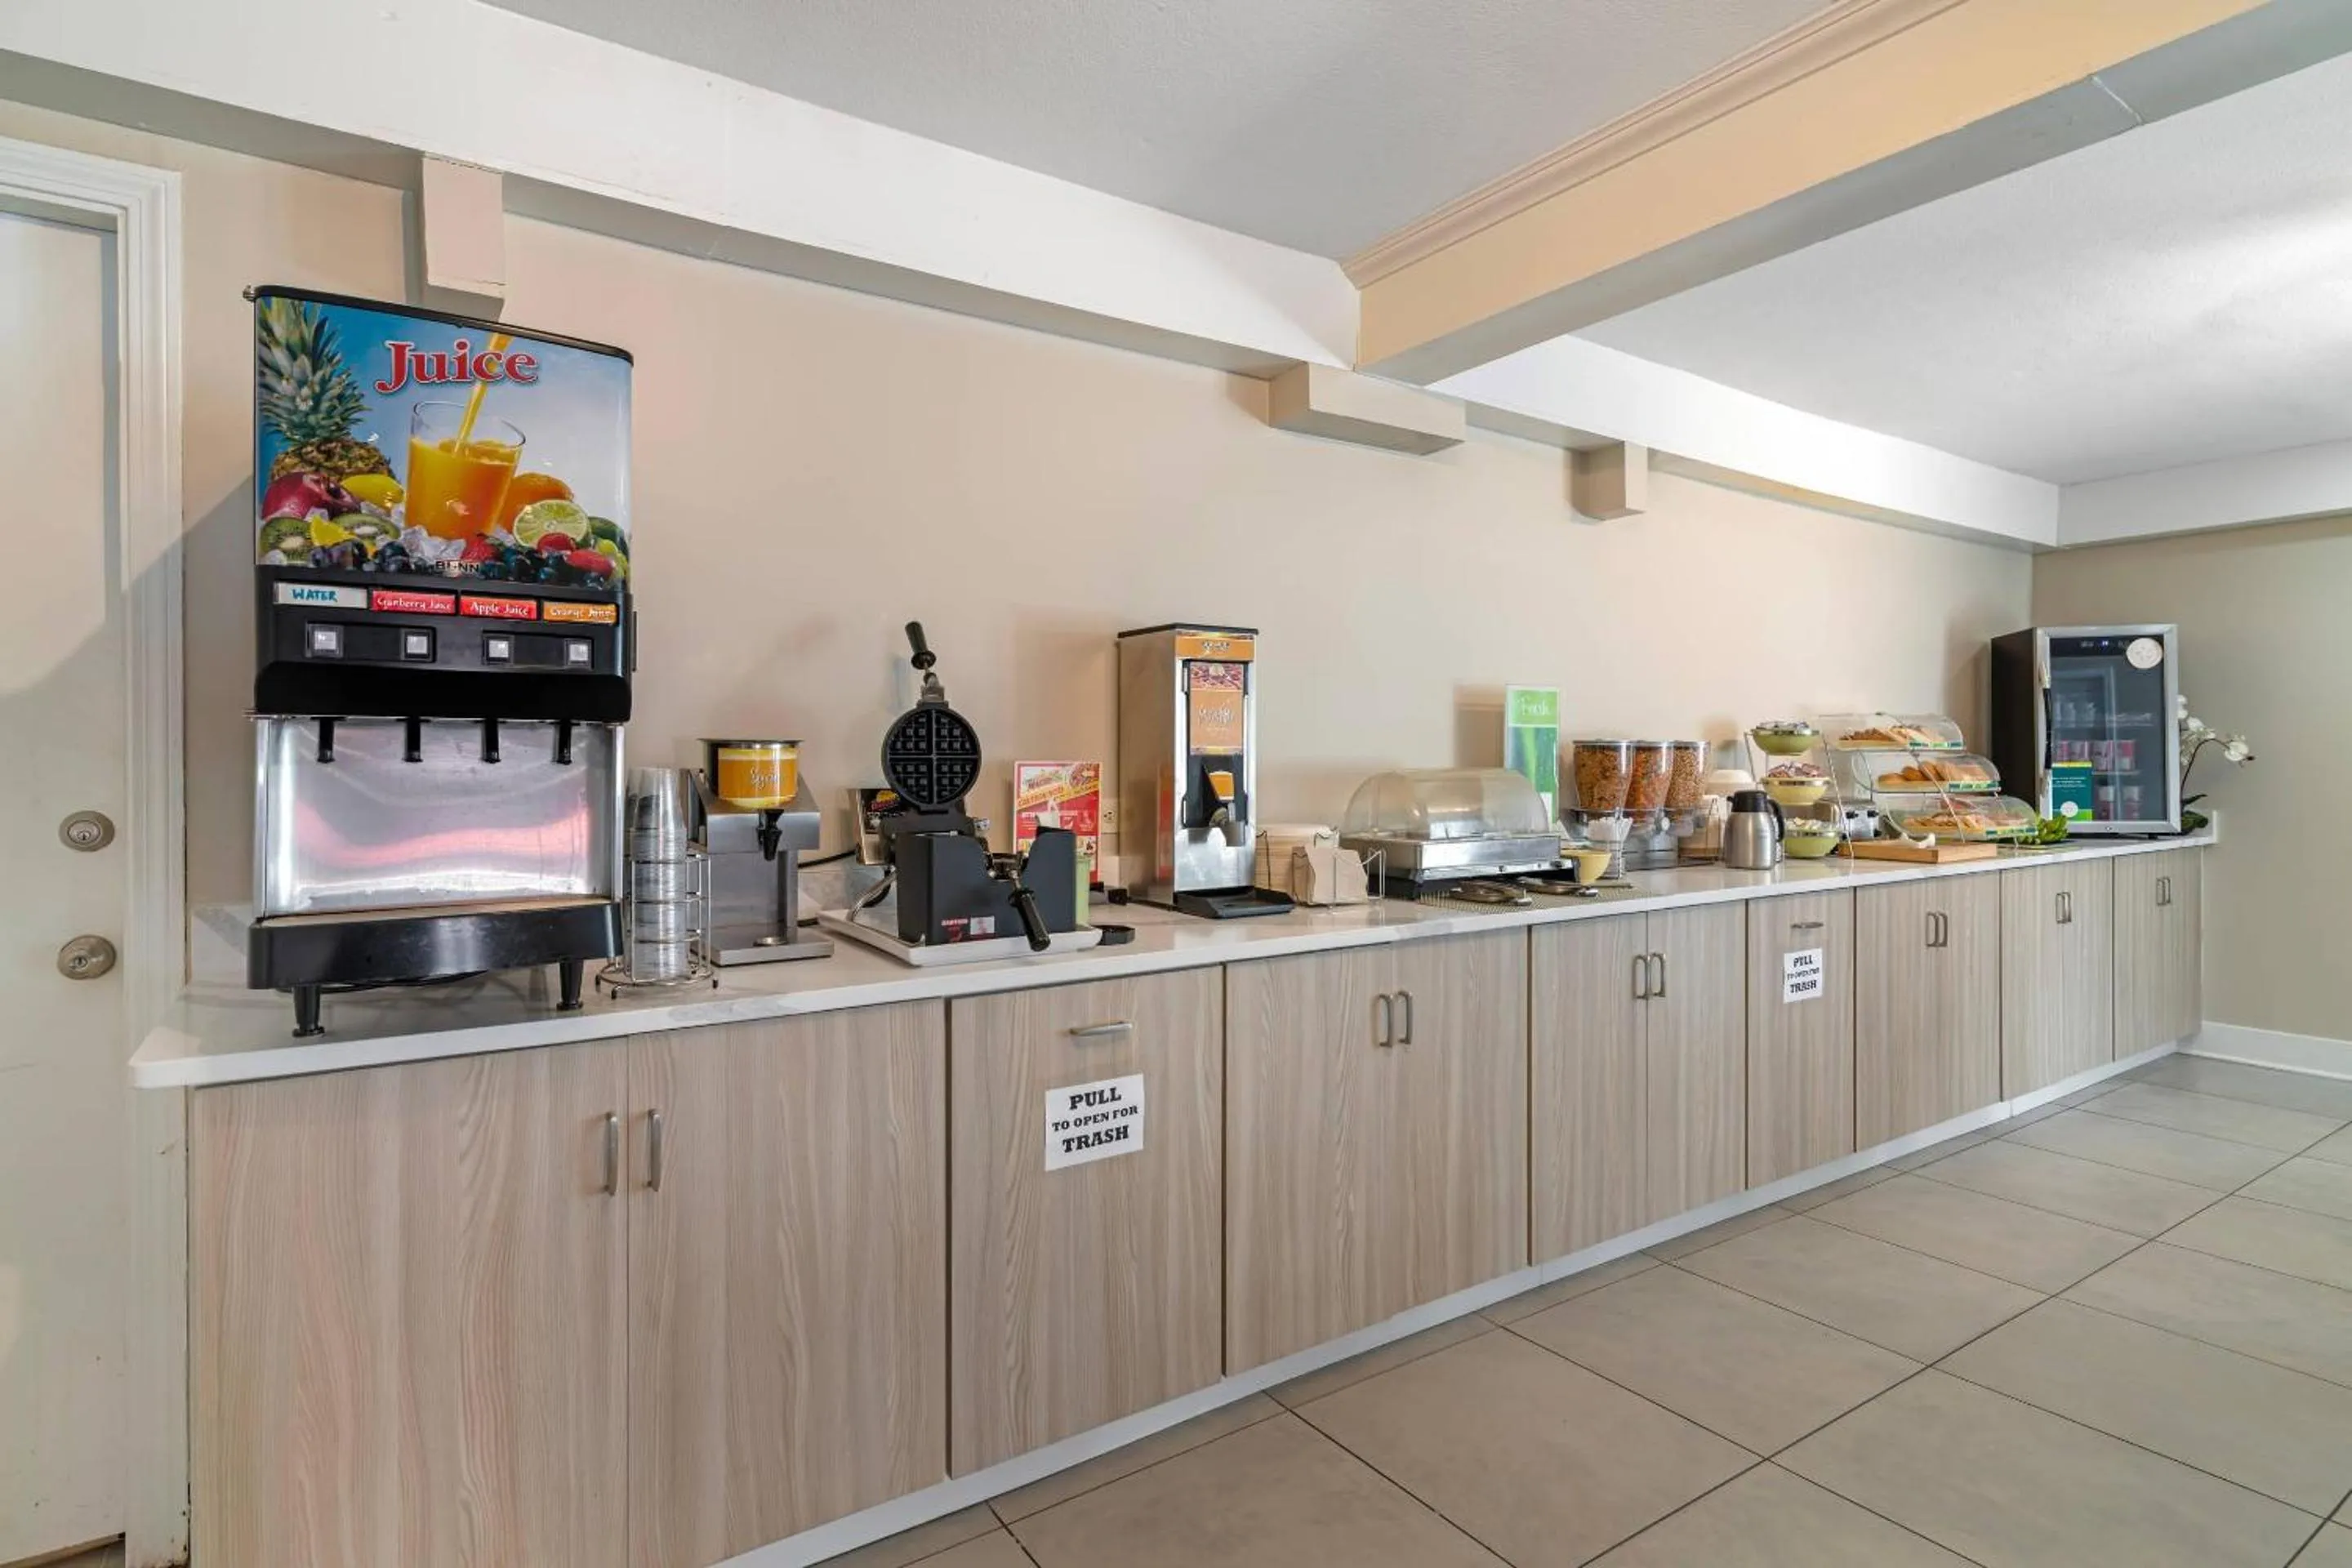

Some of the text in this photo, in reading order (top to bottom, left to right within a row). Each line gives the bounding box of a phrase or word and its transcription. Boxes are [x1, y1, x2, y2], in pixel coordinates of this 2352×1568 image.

[374, 339, 538, 394] Juice
[292, 588, 337, 603] WATER
[377, 597, 425, 609] Cranberry
[470, 601, 528, 615] Apple Juice
[1790, 980, 1817, 993] TRASH
[1069, 1087, 1122, 1110] PULL
[1052, 1105, 1138, 1131] TO OPEN FOR
[1062, 1125, 1129, 1153] TRASH
